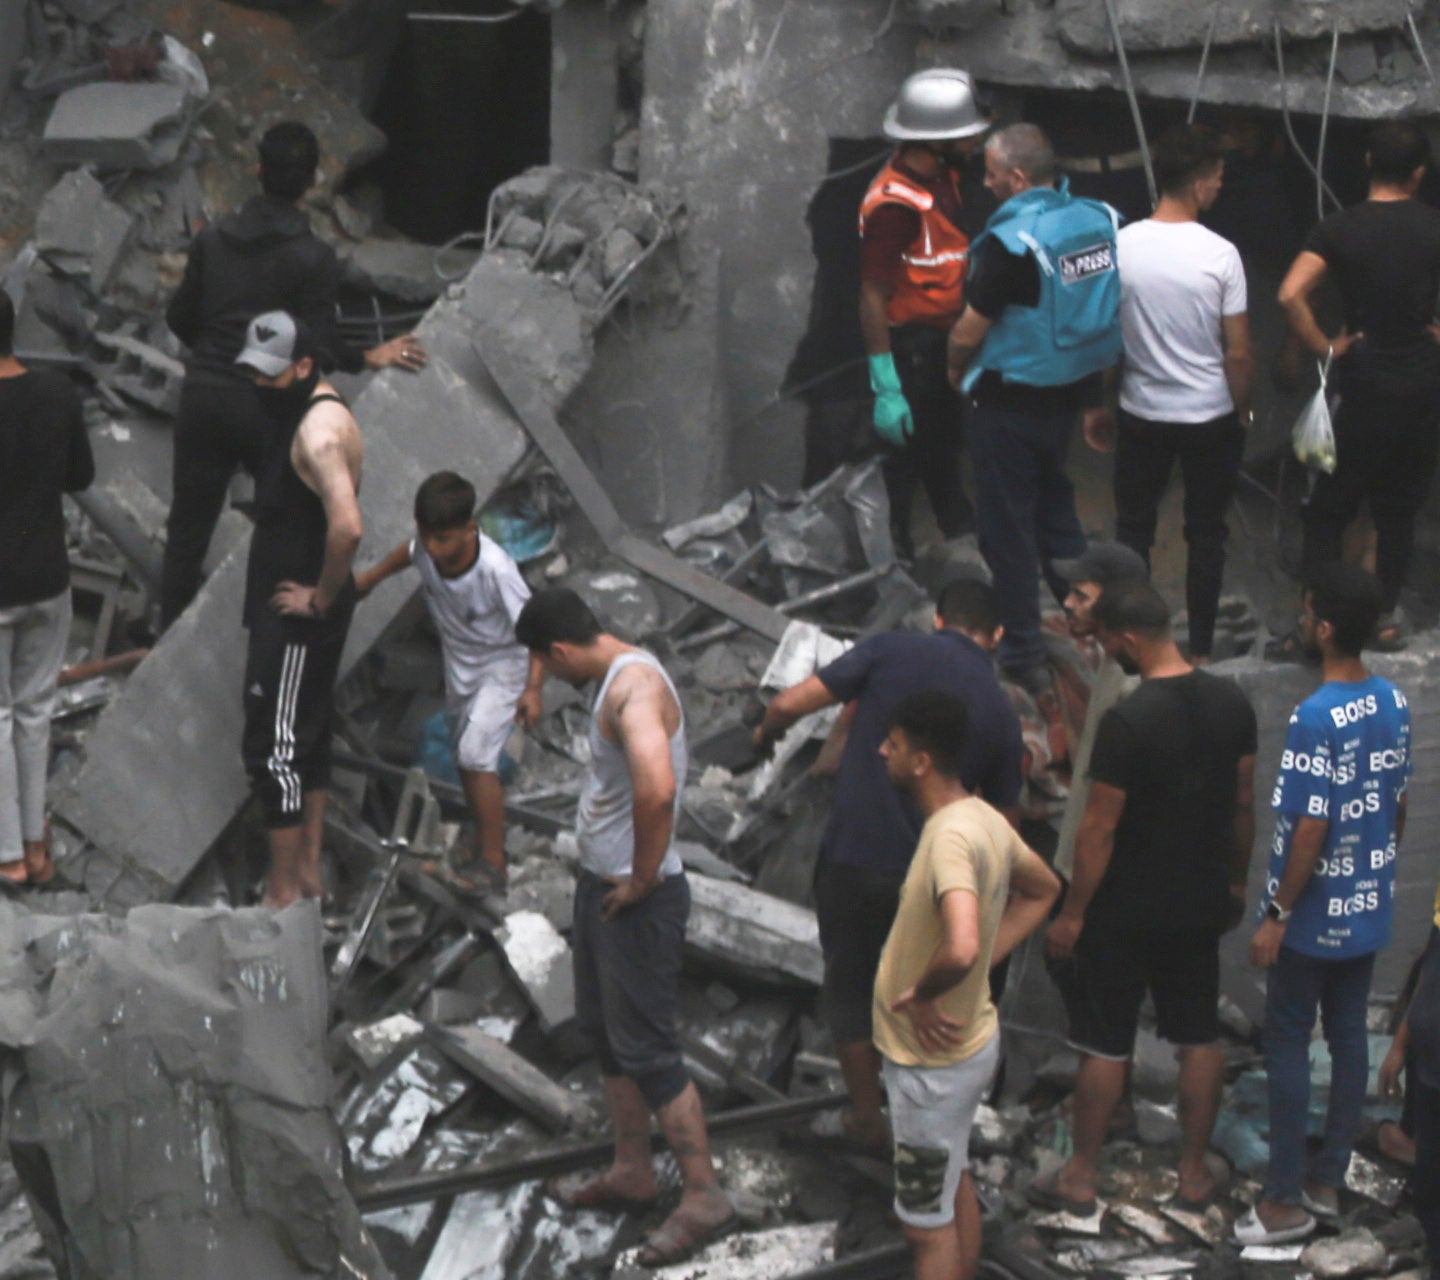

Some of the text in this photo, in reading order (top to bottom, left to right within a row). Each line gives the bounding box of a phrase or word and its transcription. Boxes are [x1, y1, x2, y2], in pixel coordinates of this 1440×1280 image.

[1075, 248, 1111, 275] PRESS
[1329, 694, 1378, 729] BOSS
[1314, 856, 1355, 878] OSS
